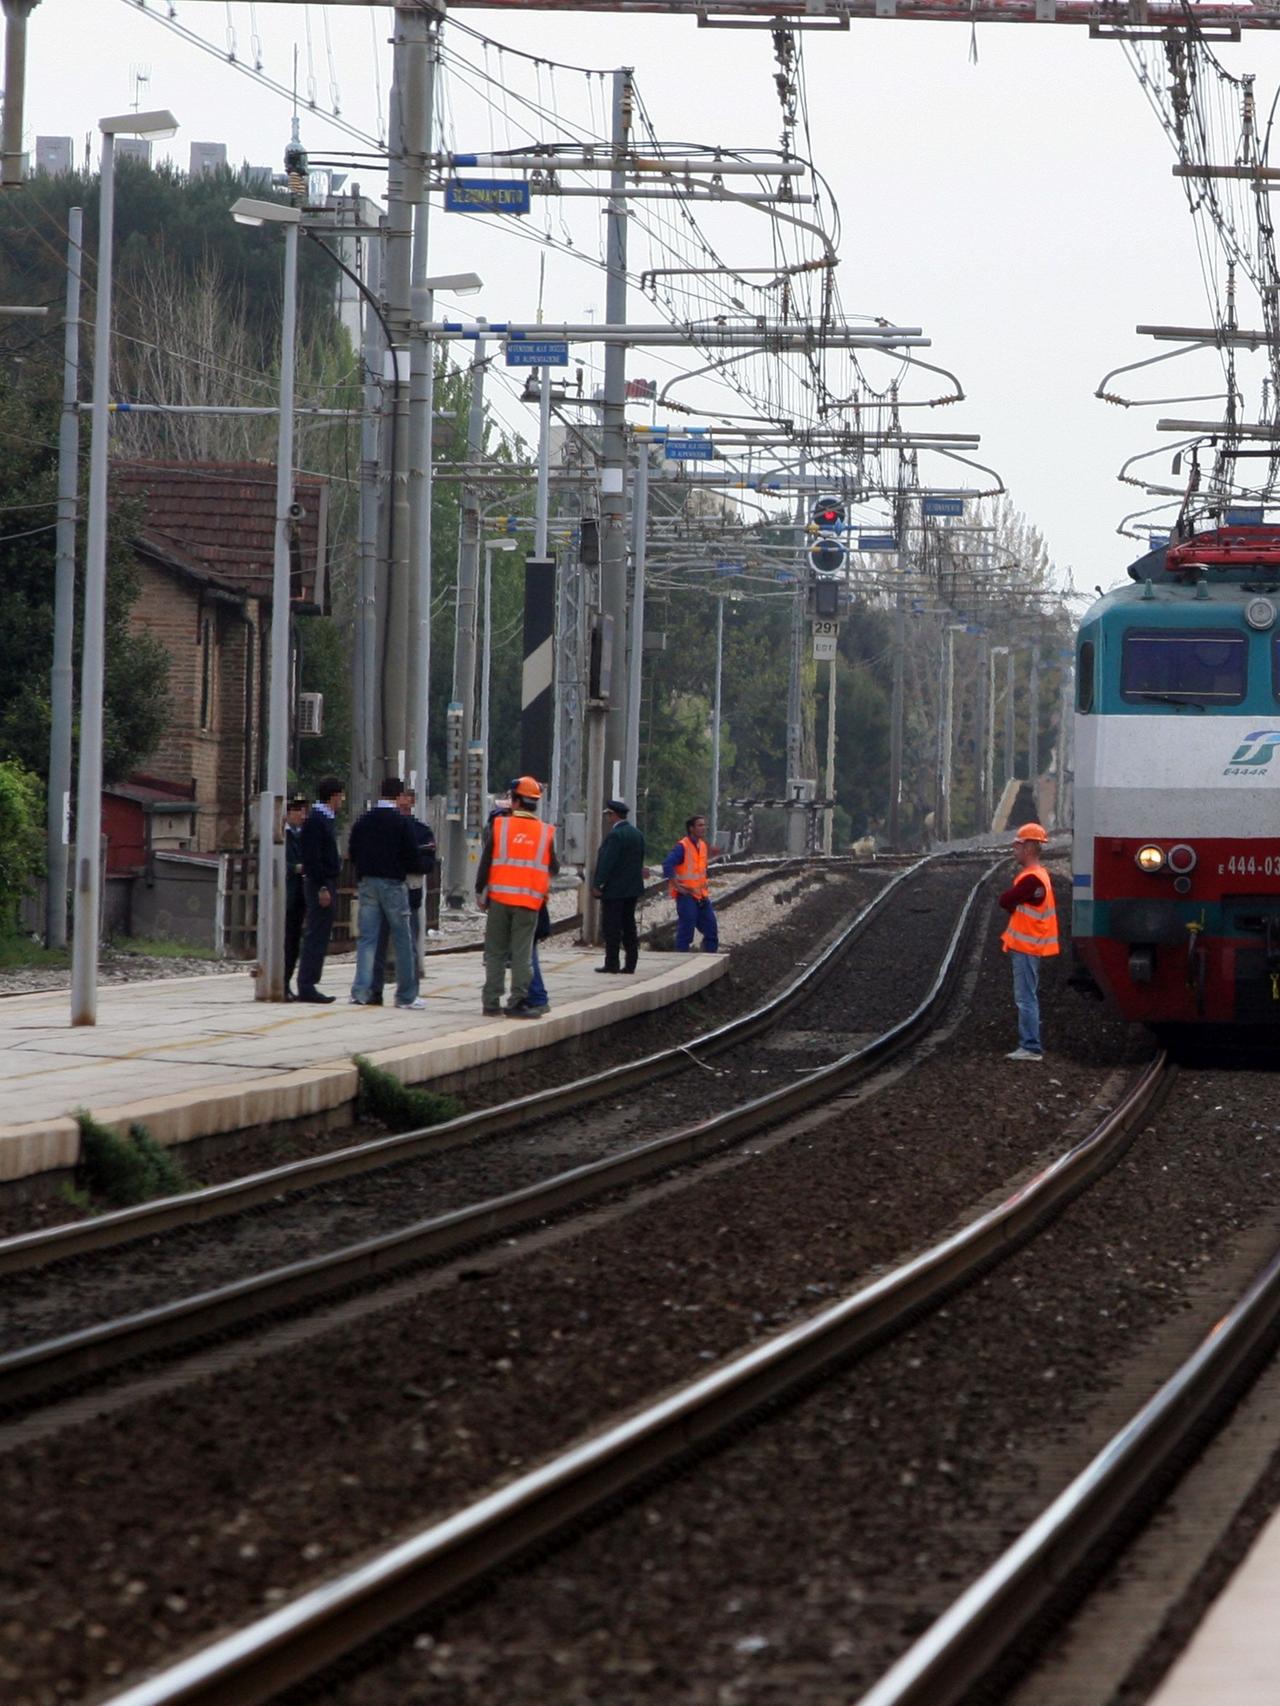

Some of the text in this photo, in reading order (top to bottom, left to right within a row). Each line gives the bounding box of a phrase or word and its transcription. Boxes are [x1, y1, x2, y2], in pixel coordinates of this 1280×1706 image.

[452, 187, 524, 204] SEZIONAMENTO
[815, 622, 838, 634] 291
[1223, 768, 1268, 776] E444R
[1217, 864, 1225, 875] E
